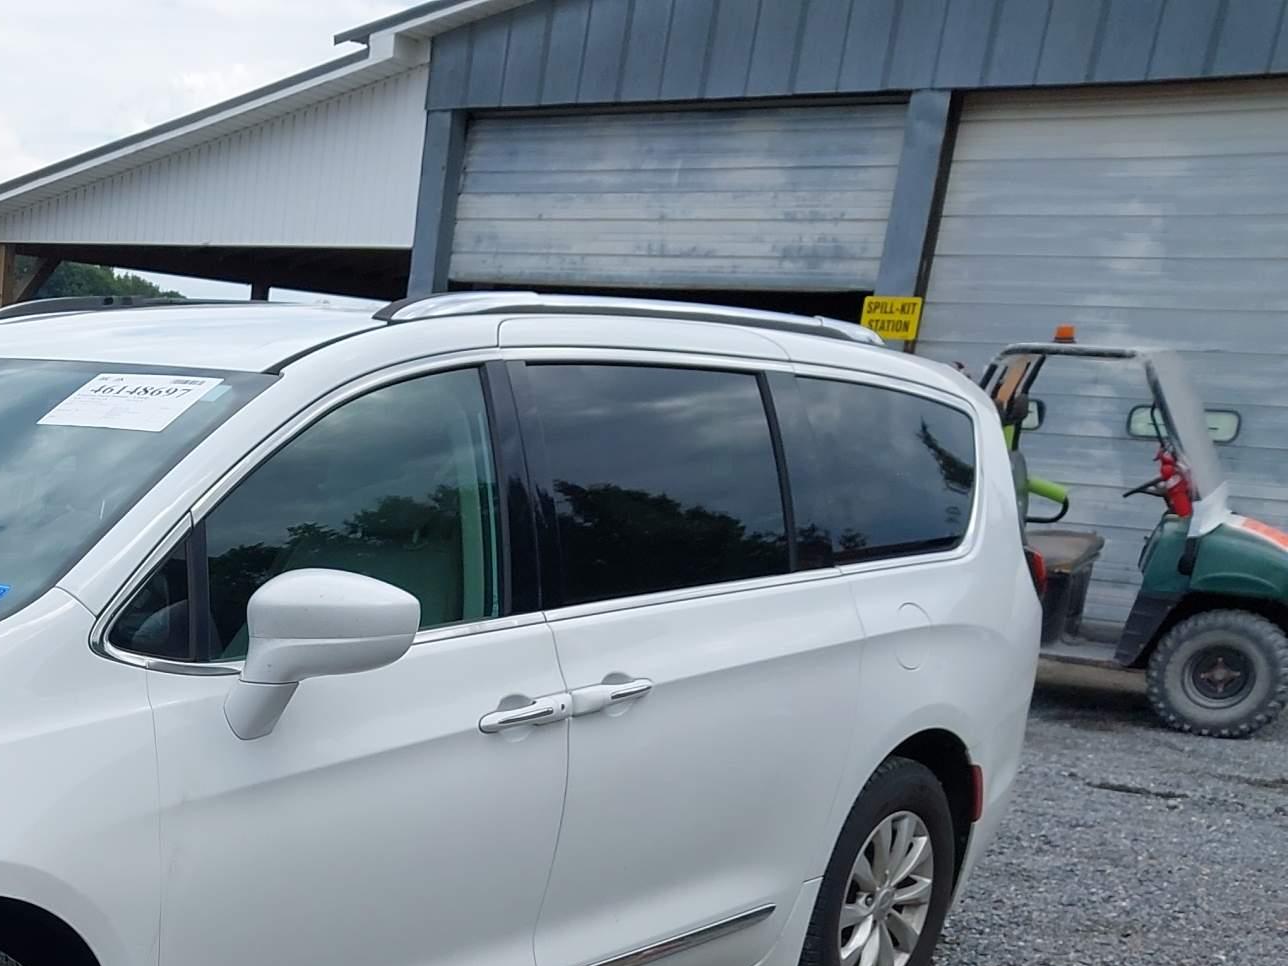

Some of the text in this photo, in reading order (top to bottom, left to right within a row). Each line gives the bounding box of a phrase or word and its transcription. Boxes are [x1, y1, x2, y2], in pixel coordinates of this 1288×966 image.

[866, 300, 918, 315] SPILL-KIT
[867, 319, 910, 332] STATION
[90, 385, 192, 399] 46148697
